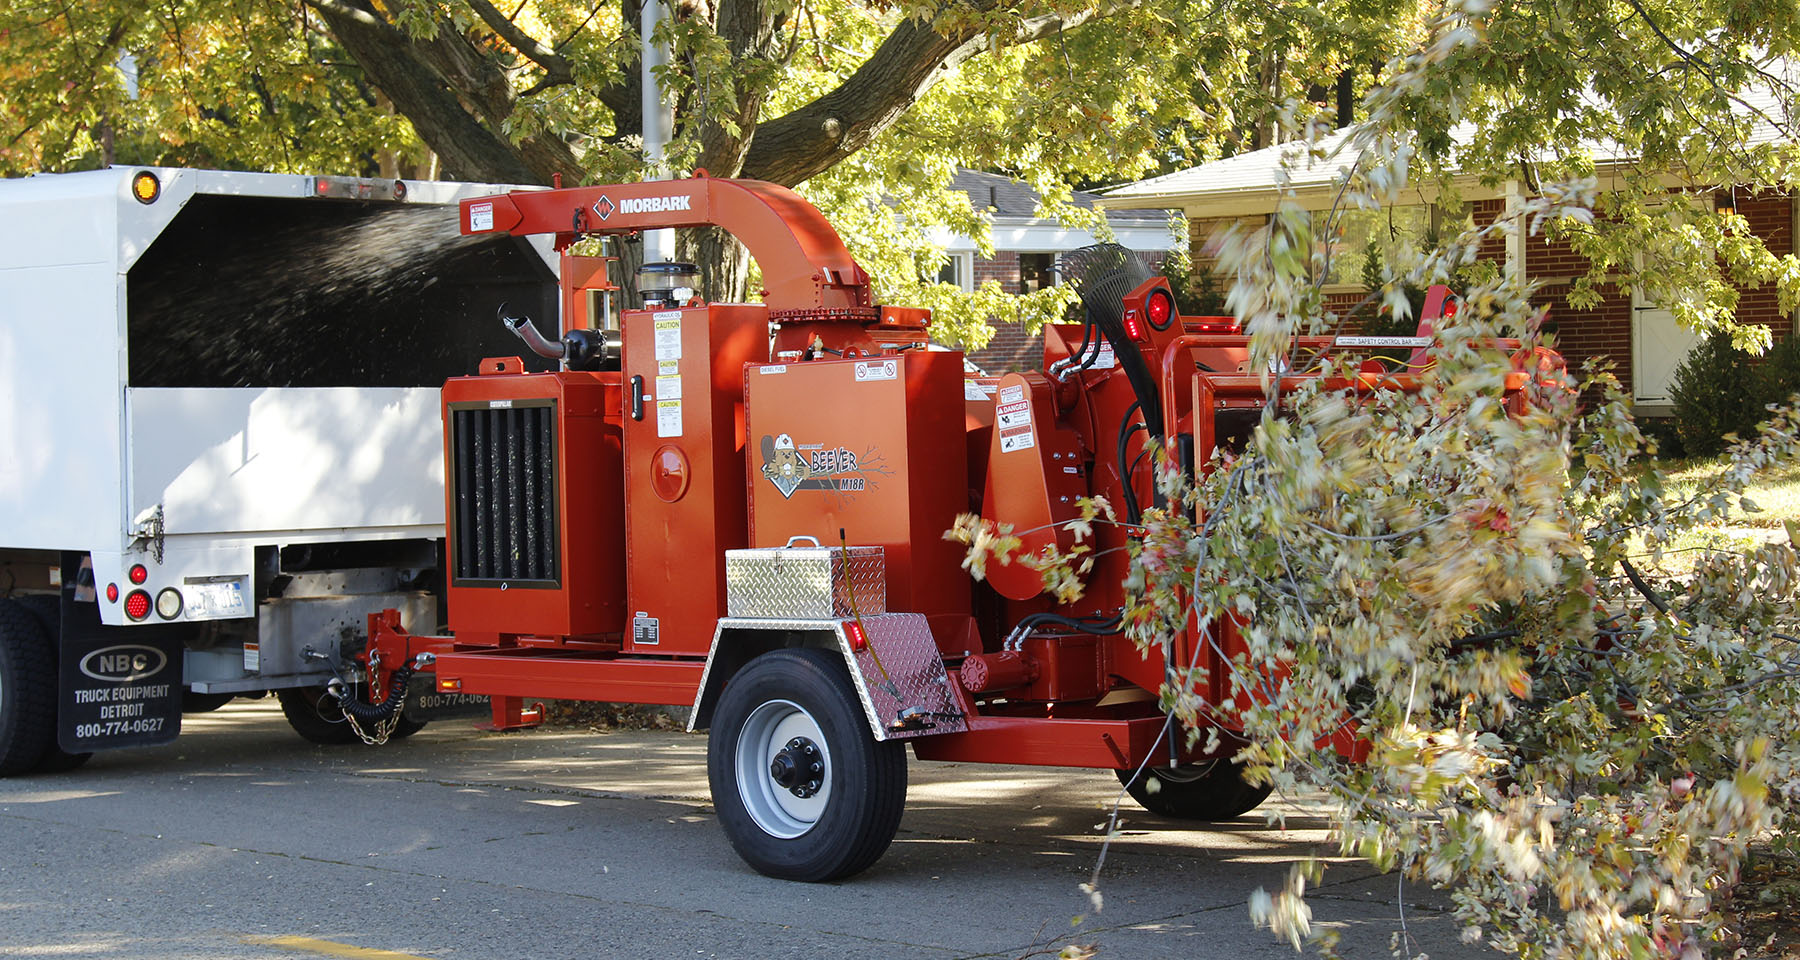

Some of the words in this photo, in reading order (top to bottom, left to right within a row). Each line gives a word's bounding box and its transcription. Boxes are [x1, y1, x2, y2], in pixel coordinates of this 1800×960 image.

[620, 195, 691, 214] MORBARK
[656, 321, 680, 330] CAUTION
[1003, 401, 1028, 413] DANGER
[811, 447, 858, 474] BEEVER
[840, 478, 865, 491] M18R
[100, 654, 148, 673] NBC
[75, 688, 111, 704] TRUCK
[112, 684, 170, 701] EQUIPMENT
[420, 694, 492, 709] 800-774-062
[100, 703, 145, 719] DETROIT
[76, 718, 164, 738] 800-774-0627
